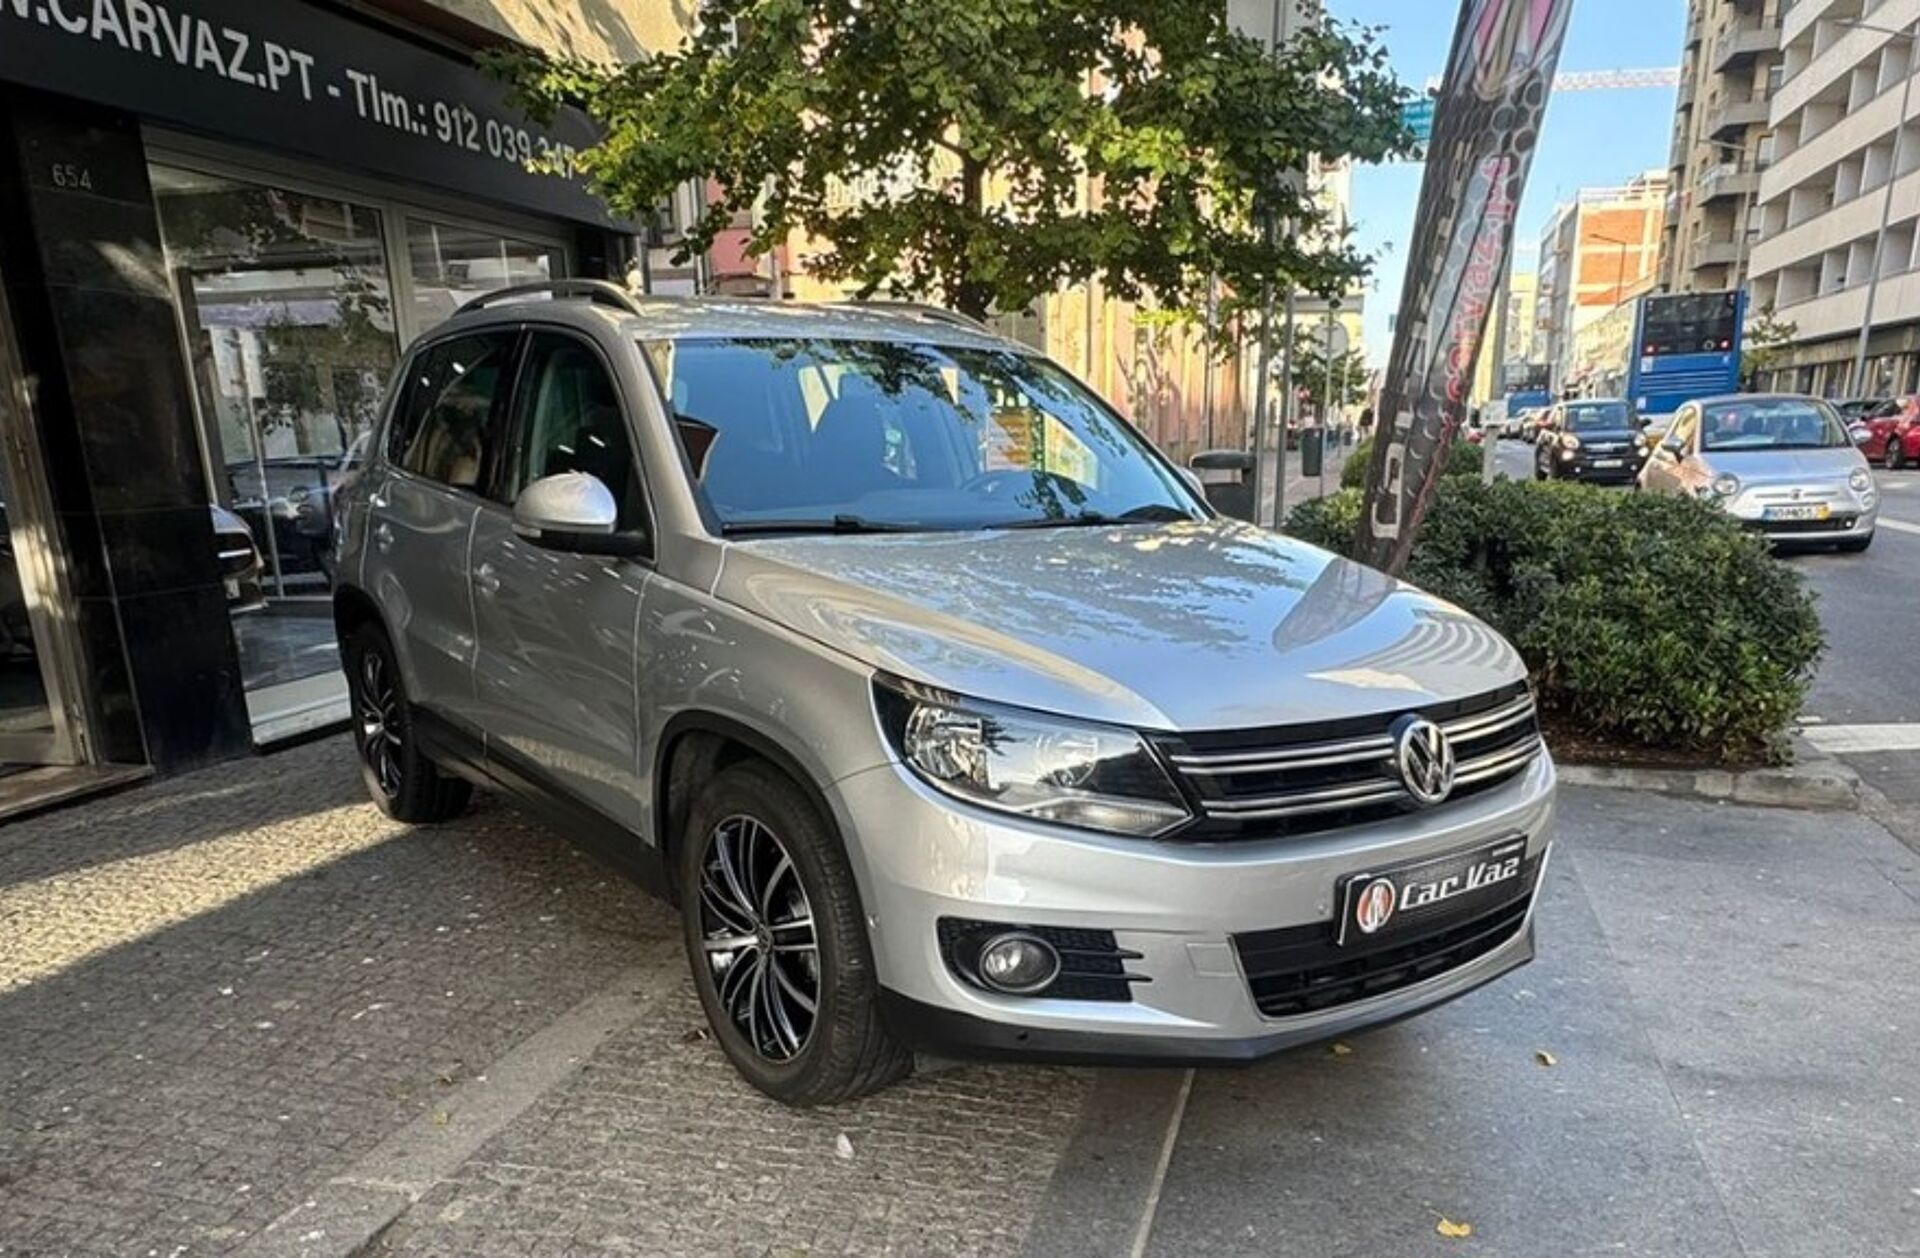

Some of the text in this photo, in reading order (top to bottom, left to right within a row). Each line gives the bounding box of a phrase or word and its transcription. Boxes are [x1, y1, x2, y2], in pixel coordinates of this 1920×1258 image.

[346, 69, 428, 136] Tlm.:
[434, 102, 481, 150] 912
[486, 119, 531, 165] 039
[53, 163, 92, 190] 654
[1399, 877, 1459, 911] Car
